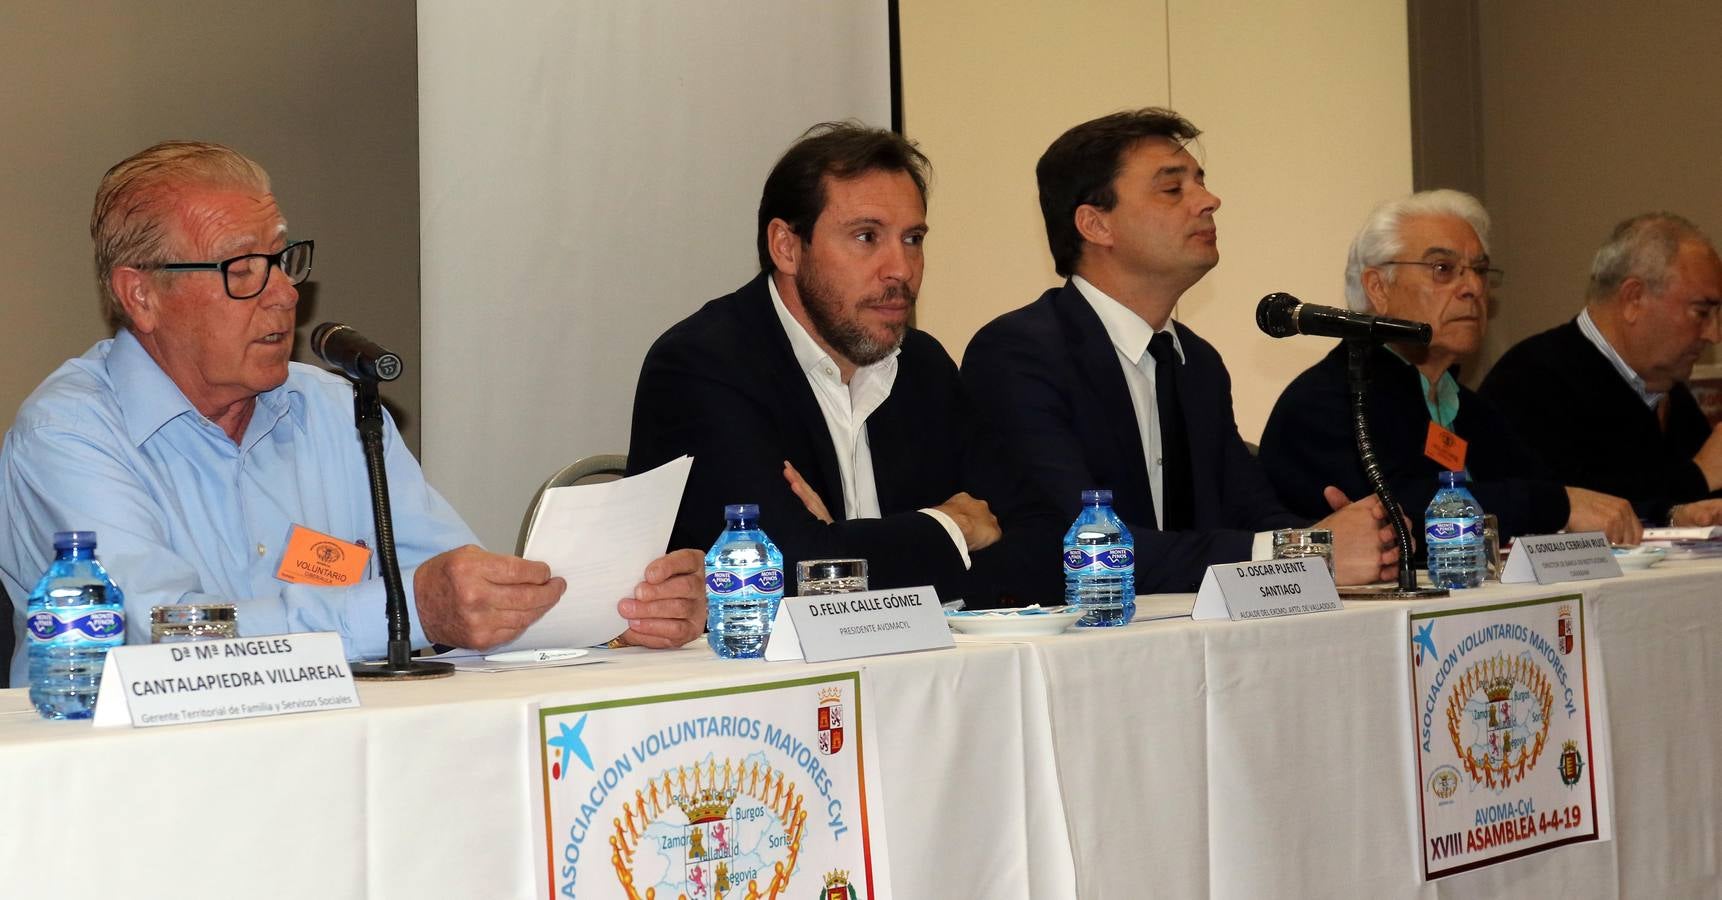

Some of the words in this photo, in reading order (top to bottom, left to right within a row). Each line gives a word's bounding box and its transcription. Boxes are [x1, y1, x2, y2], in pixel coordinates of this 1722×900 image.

[1535, 541, 1566, 554] GONZALO
[1565, 538, 1592, 551] CEBRIÁN
[1590, 538, 1607, 548] RUIZ
[296, 560, 347, 582] VOLUNTARIO
[1236, 567, 1248, 578] D.
[1247, 564, 1275, 577] OSCAR
[1275, 561, 1307, 574] PUENTE
[1259, 583, 1302, 598] SANTIAGO
[809, 601, 851, 617] D.FELIX
[850, 598, 883, 613] CALLE
[882, 593, 923, 609] GÓMEZ
[1240, 610, 1260, 619] ALCALDE
[1310, 602, 1337, 611] VALLADOLID
[839, 624, 877, 636] PRESIDENTE
[877, 620, 912, 632] AVOMACYL
[171, 647, 191, 662] Dª
[196, 644, 219, 660] Mª
[225, 638, 293, 658] ANGELES
[132, 671, 265, 697] CANTALAPIEDRA
[266, 664, 346, 684] VILLAREAL
[1423, 649, 1459, 753] ASOCIACION
[1457, 623, 1529, 657] VOLUNTARIOS
[141, 711, 179, 724] Gerente
[181, 705, 227, 720] Territorial
[228, 704, 240, 716] de
[242, 701, 274, 714] Familia
[274, 702, 281, 713] y
[319, 694, 353, 707] Sociales
[561, 753, 633, 900] ASOCIACION
[631, 716, 761, 764] VOLUNTARIOS
[735, 806, 765, 821] Burgos
[1475, 798, 1536, 826] AVOMA-CyL
[1430, 832, 1463, 862] XVIII
[1467, 815, 1537, 854] ASAMBLEA
[1539, 805, 1582, 834] 4-4-19
[728, 867, 757, 887] egovia
